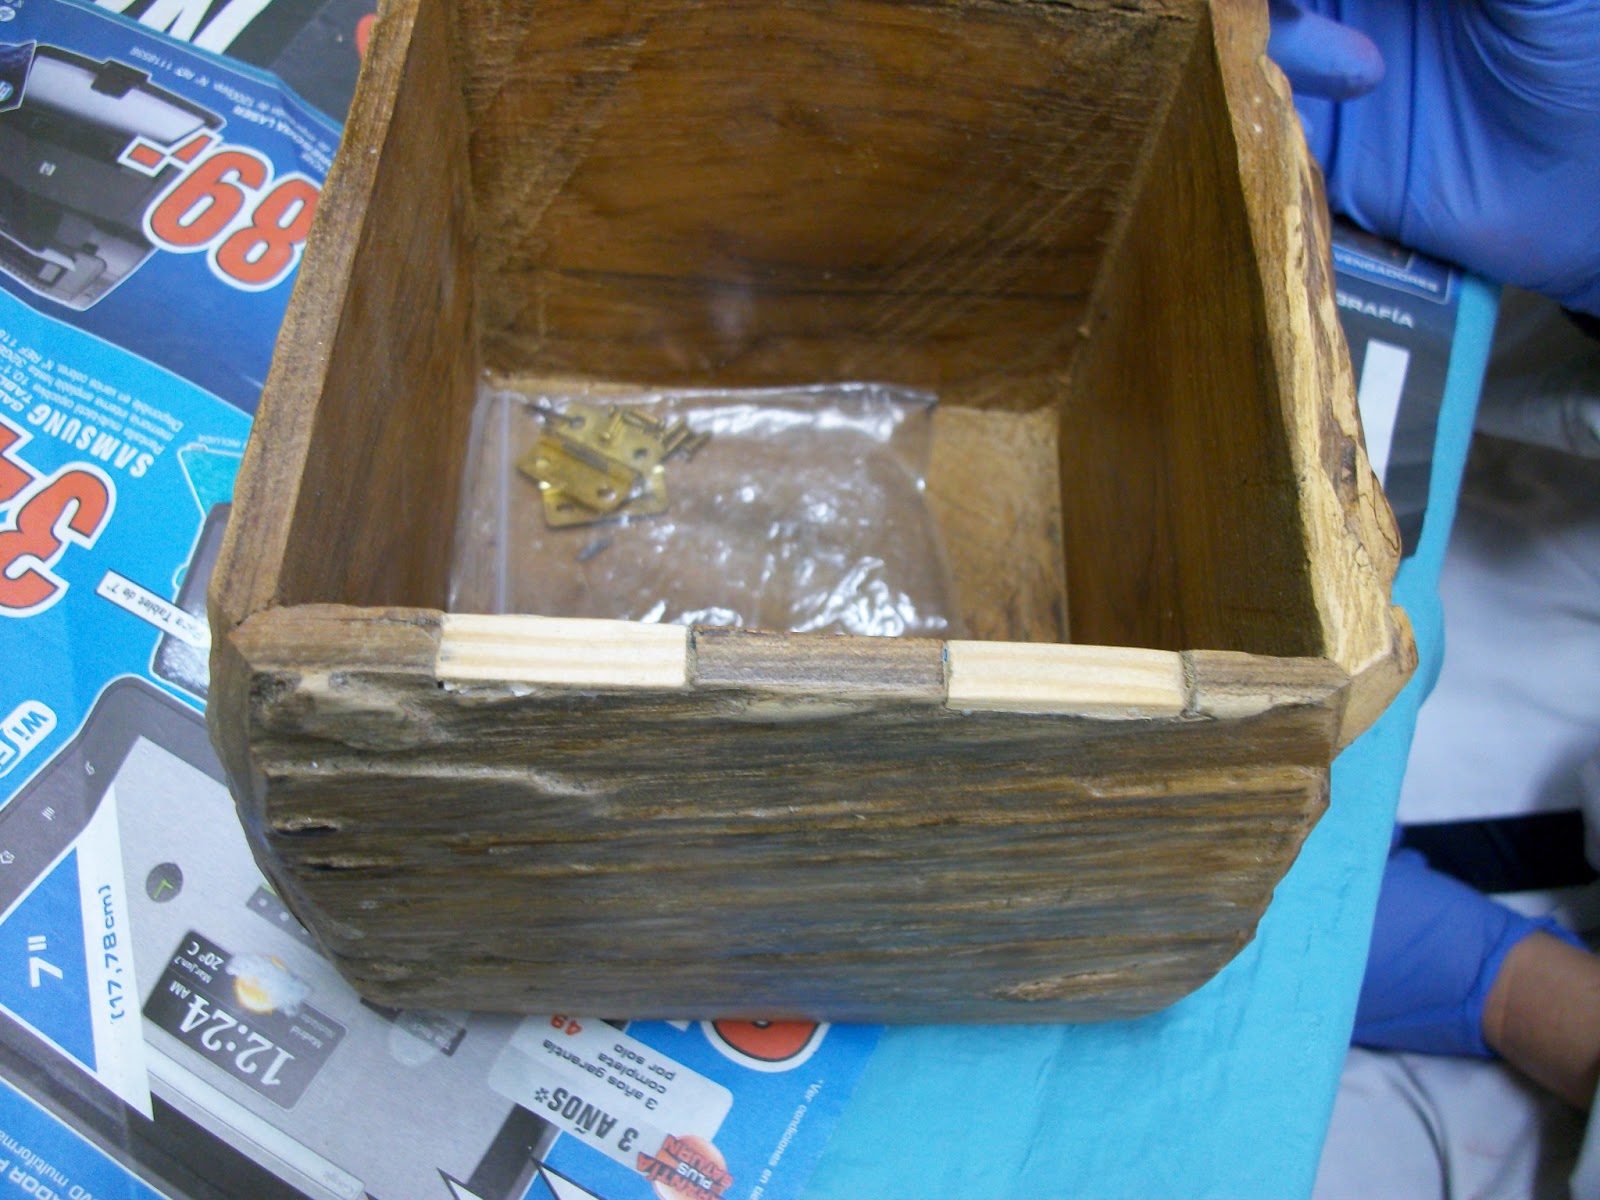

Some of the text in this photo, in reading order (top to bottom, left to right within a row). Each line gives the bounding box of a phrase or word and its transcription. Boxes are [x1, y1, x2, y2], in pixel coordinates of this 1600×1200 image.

[26, 402, 155, 478] SAMSUNG
[168, 979, 296, 1086] 12:24 AM
[541, 1038, 660, 1111] 3 años garantía
[597, 1052, 668, 1095] completa
[612, 1042, 678, 1082] por solo
[617, 1126, 640, 1153] 3
[676, 1162, 714, 1190] PLUS
